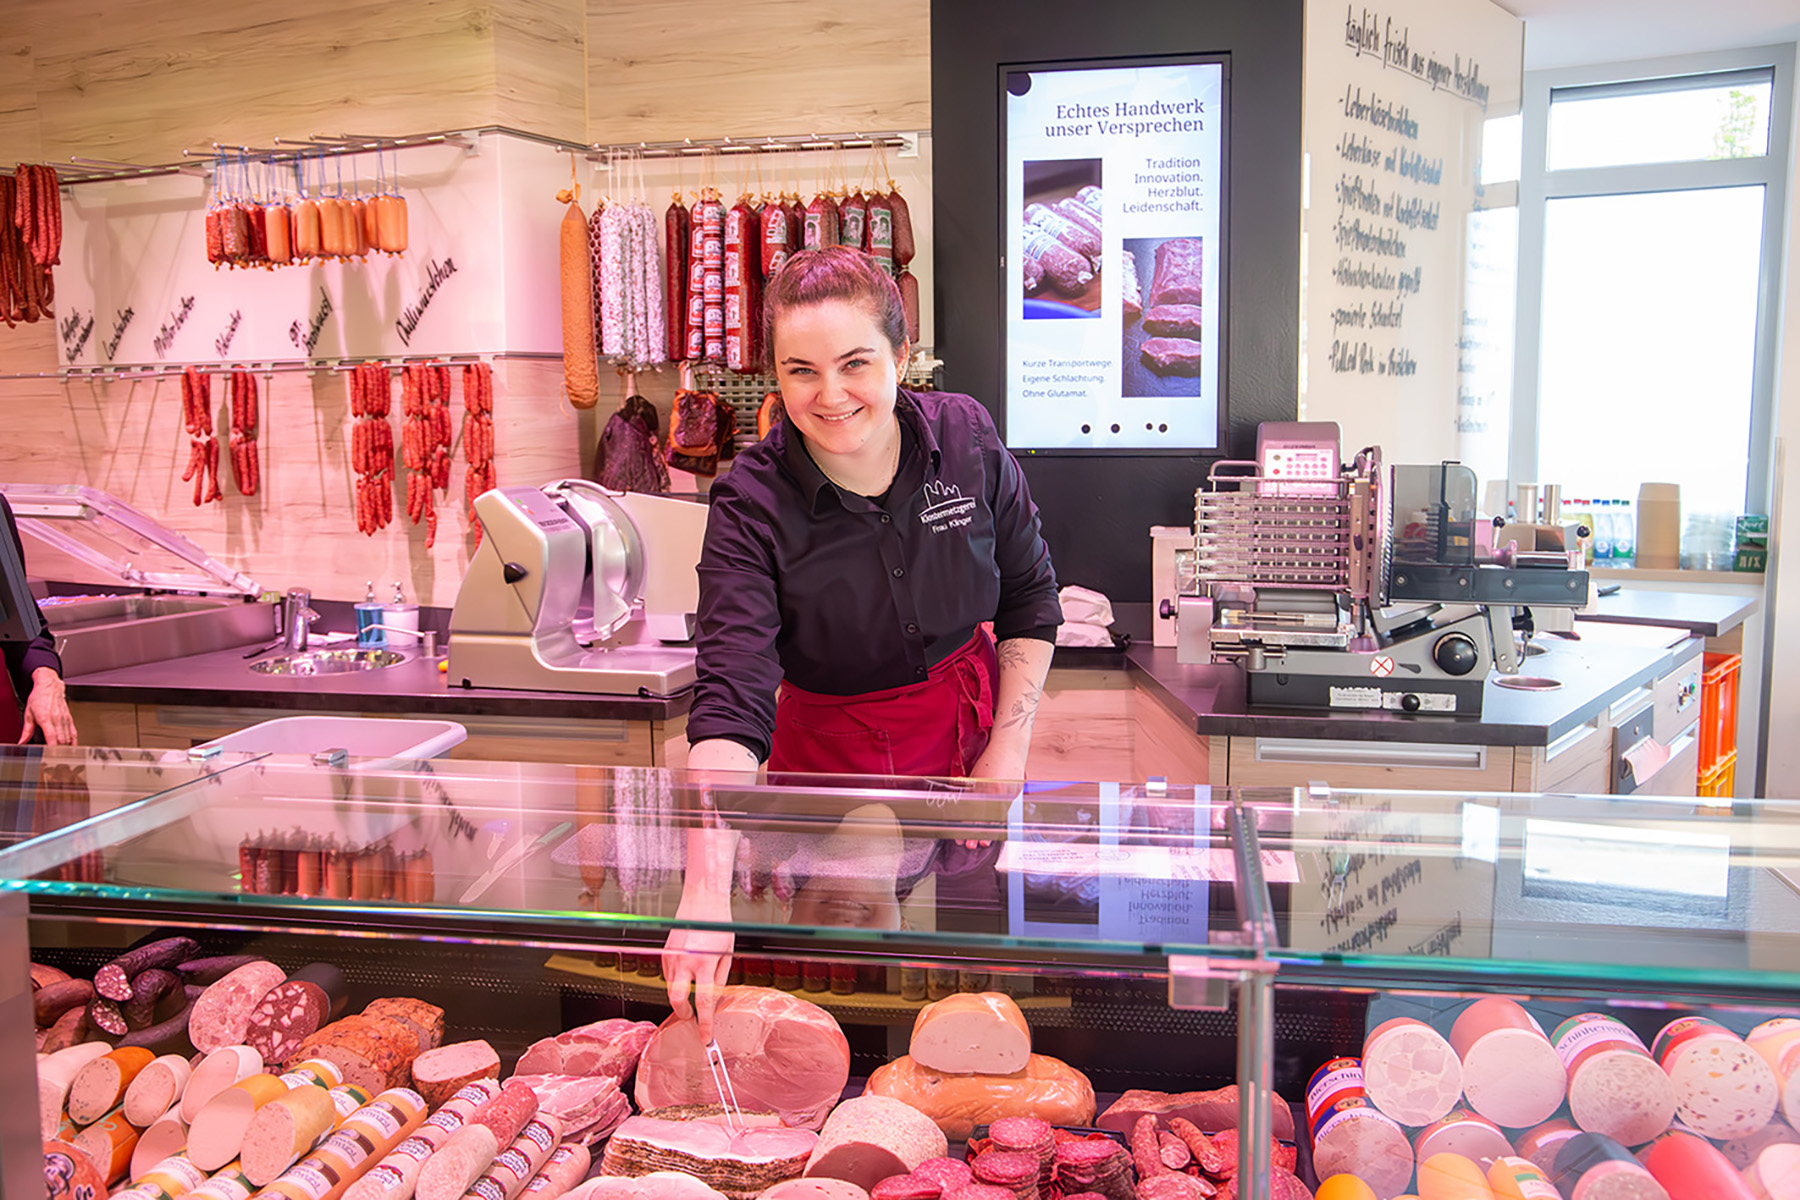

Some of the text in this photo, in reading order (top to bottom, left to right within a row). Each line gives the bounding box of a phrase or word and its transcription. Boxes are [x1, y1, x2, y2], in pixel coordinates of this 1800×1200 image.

[1383, 16, 1409, 69] frisch
[1056, 98, 1205, 119] Echtes Handwerk
[1045, 117, 1204, 137] unser Versprechen
[1145, 157, 1201, 169] Tradition
[1134, 171, 1204, 184] Innovation.
[1147, 186, 1204, 198] Herzblut.
[1122, 199, 1204, 214] Leidenschaft.
[1022, 360, 1047, 368] Kurze
[1022, 374, 1051, 385] Eigene
[1022, 389, 1046, 398] Ohne
[932, 523, 948, 534] Frau
